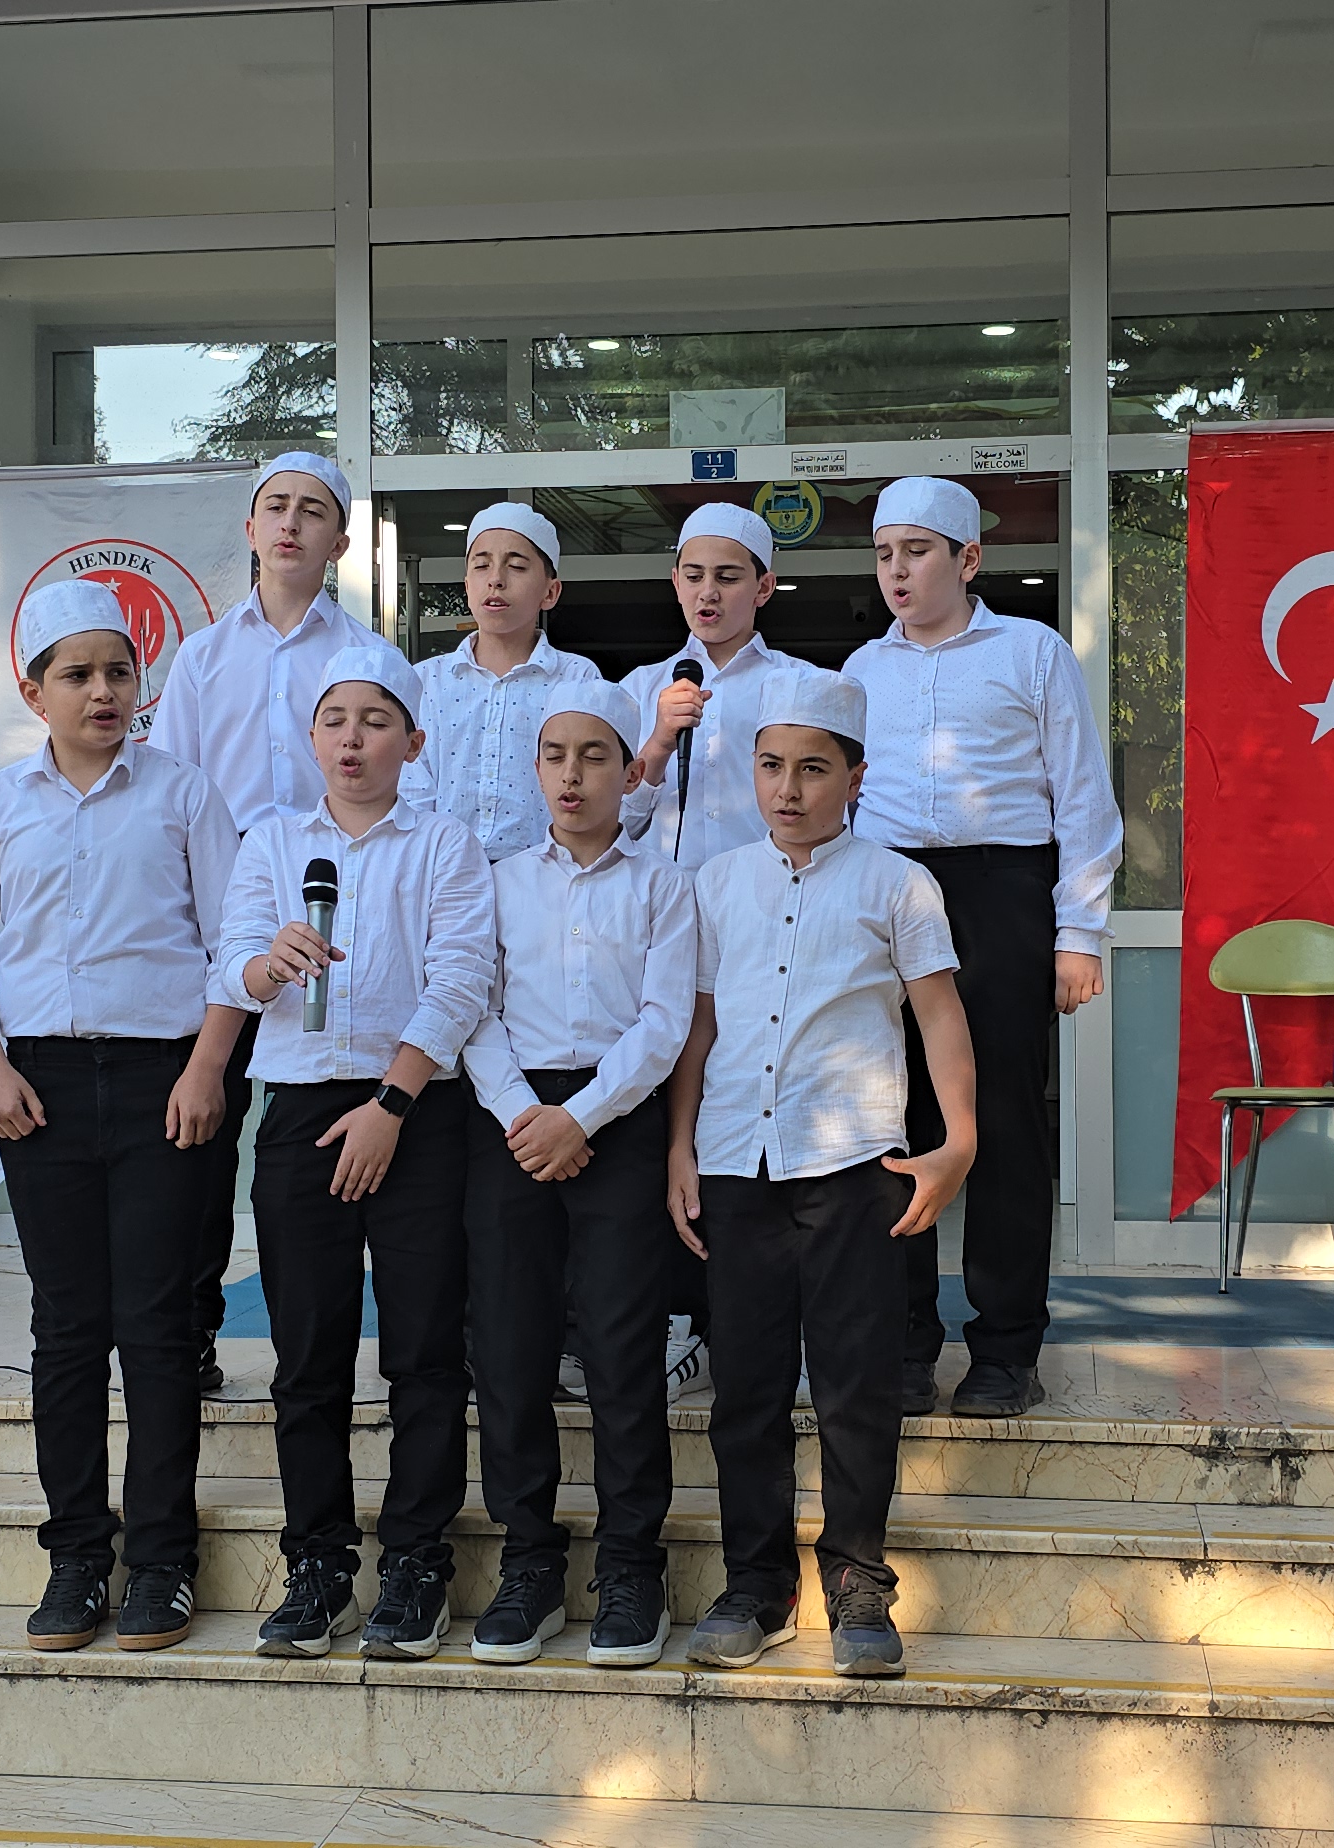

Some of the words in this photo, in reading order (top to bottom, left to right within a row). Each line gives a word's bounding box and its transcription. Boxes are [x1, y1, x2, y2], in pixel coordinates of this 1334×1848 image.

[706, 452, 722, 465] 11
[974, 460, 1025, 470] WELCOME
[711, 468, 718, 478] 2
[67, 550, 157, 575] HENDEK
